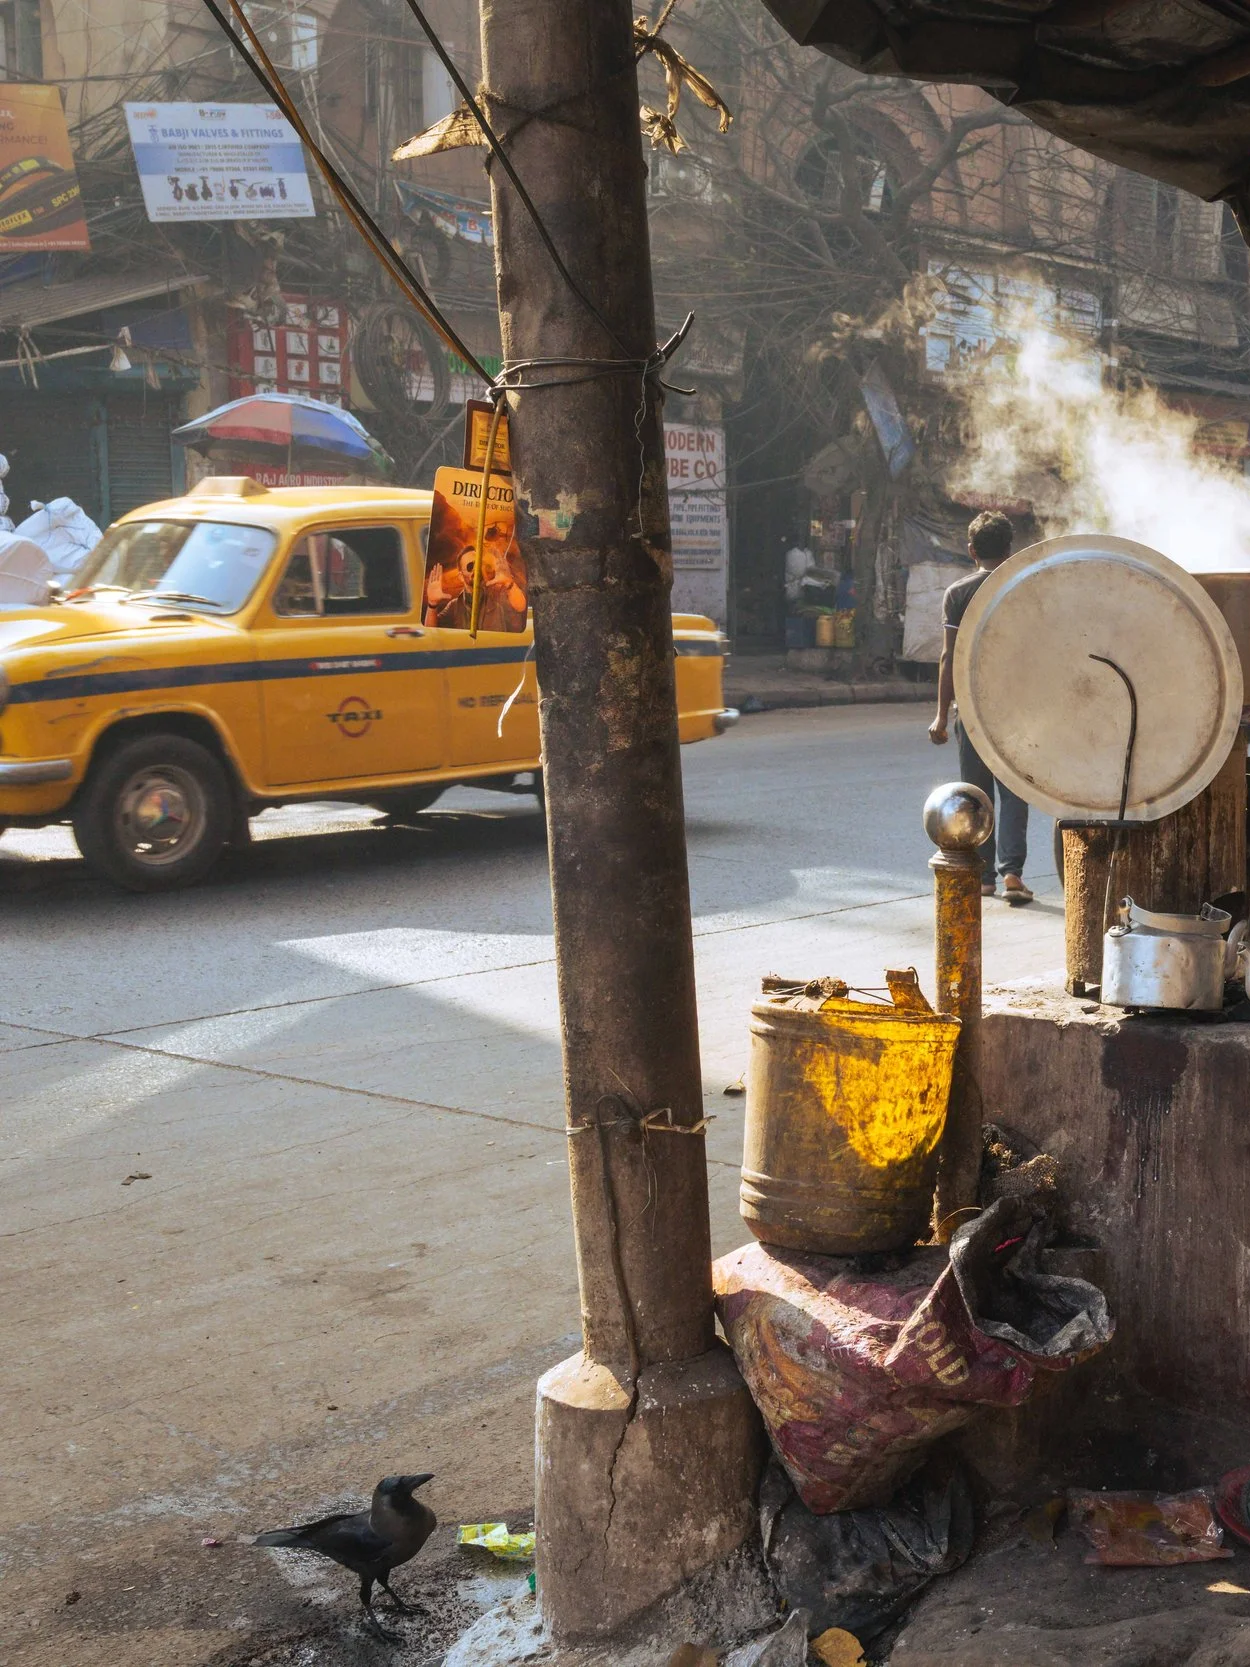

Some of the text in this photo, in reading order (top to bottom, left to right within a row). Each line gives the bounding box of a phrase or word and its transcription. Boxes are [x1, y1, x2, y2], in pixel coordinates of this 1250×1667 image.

[161, 128, 284, 140] BABJI VALVES & FITTINGS
[51, 193, 69, 207] SPC
[479, 440, 505, 449] DIRTOR
[693, 459, 718, 479] CO
[255, 472, 277, 486] RAJ
[478, 691, 537, 708] REFSAL
[324, 708, 384, 724] TAXI
